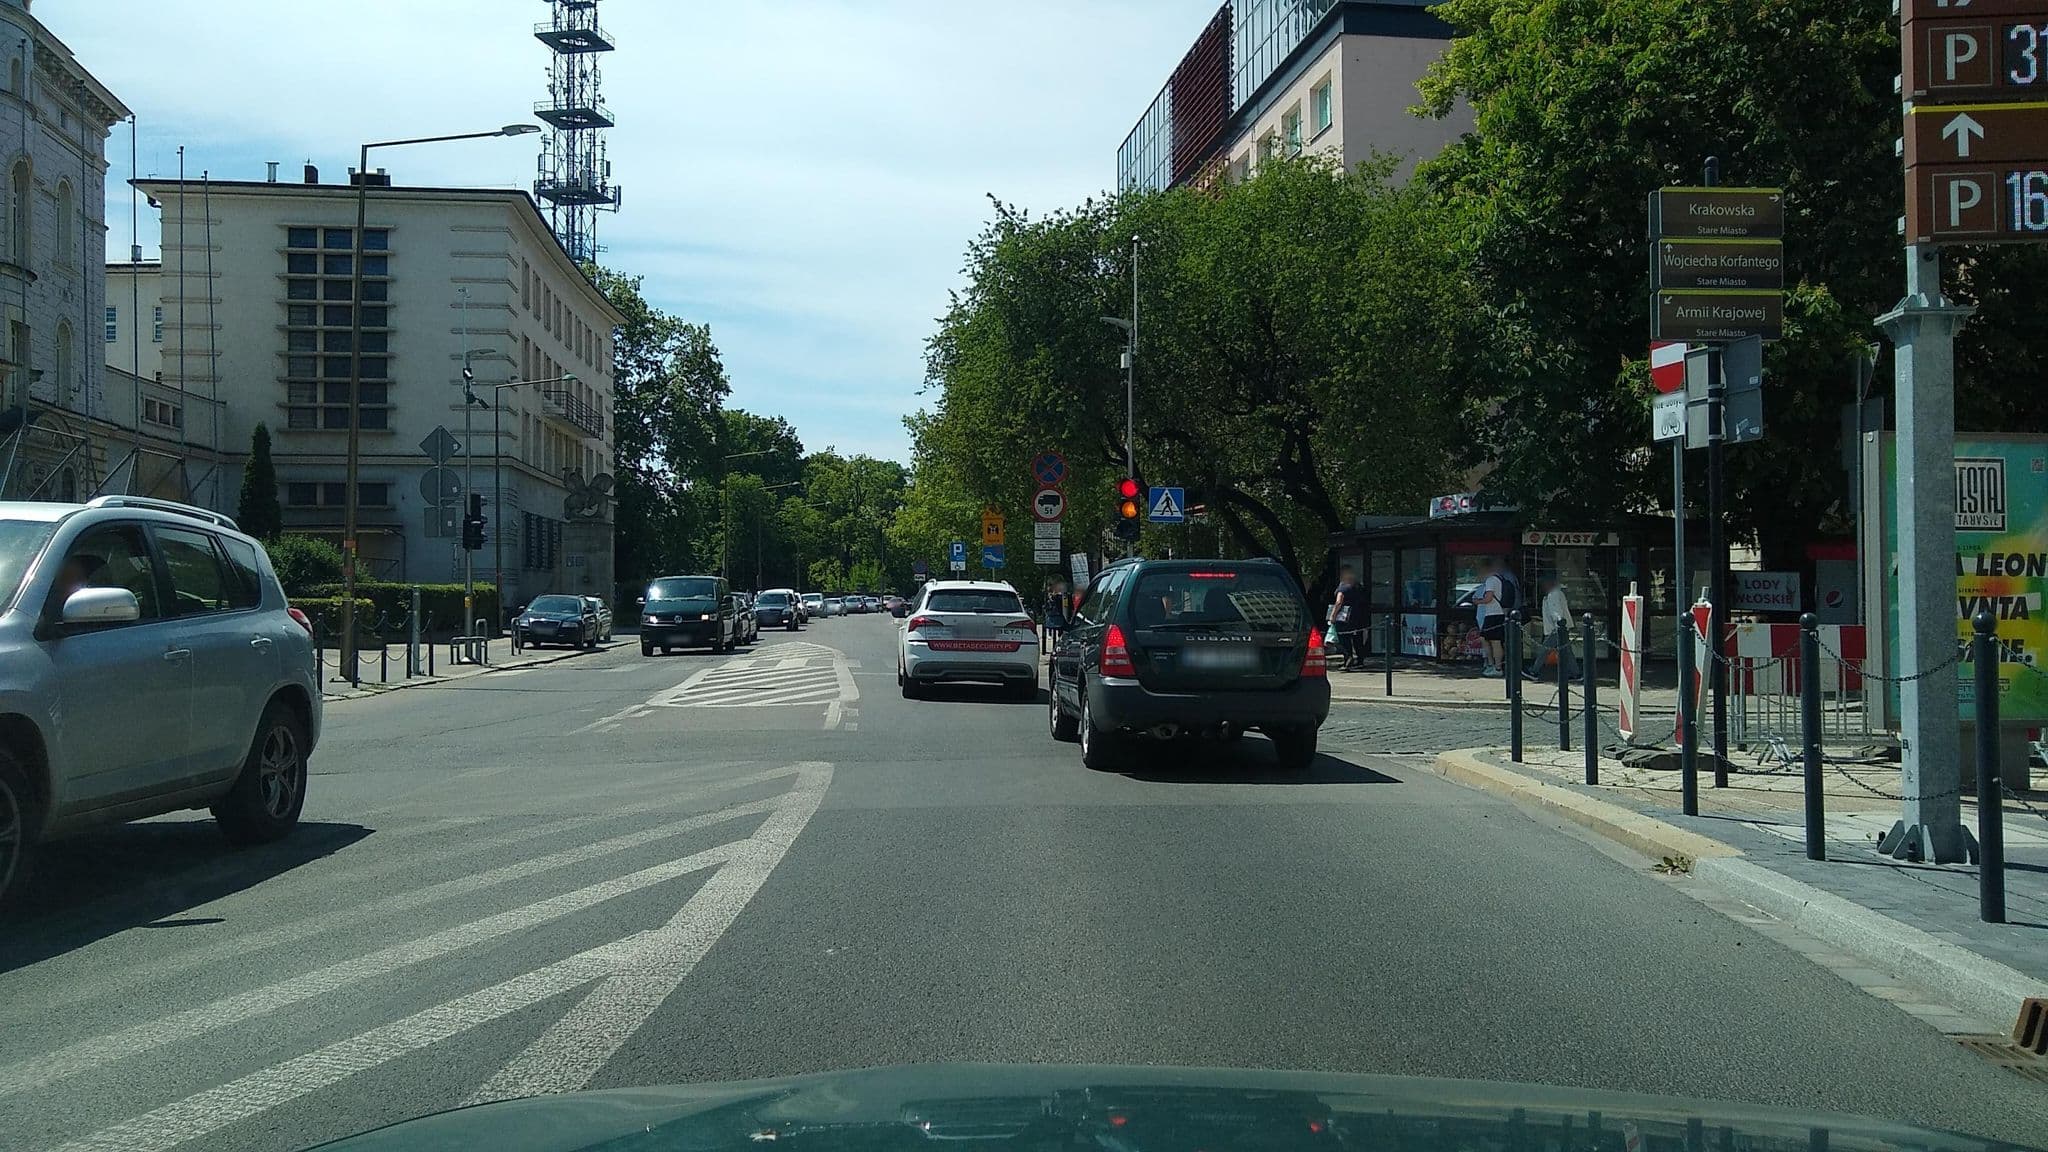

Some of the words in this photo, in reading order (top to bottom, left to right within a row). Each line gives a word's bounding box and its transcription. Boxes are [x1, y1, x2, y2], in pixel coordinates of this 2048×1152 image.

[1946, 33, 1978, 80] P
[1689, 203, 1755, 216] Krakowska
[1950, 179, 1982, 227] P
[1697, 225, 1719, 235] Stare
[1720, 225, 1748, 235] Miasto
[1664, 254, 1718, 270] Wojciecha
[1720, 254, 1779, 271] Korfantego
[1697, 277, 1718, 286] Stare
[1719, 277, 1747, 286] Miasto
[1676, 306, 1709, 318] Armii
[1712, 306, 1766, 321] Krajowej
[1696, 328, 1718, 337] Stare
[1719, 328, 1746, 337] Miasto
[953, 544, 963, 557] P
[1976, 553, 2047, 577] LEON
[1744, 579, 1780, 590] LODY
